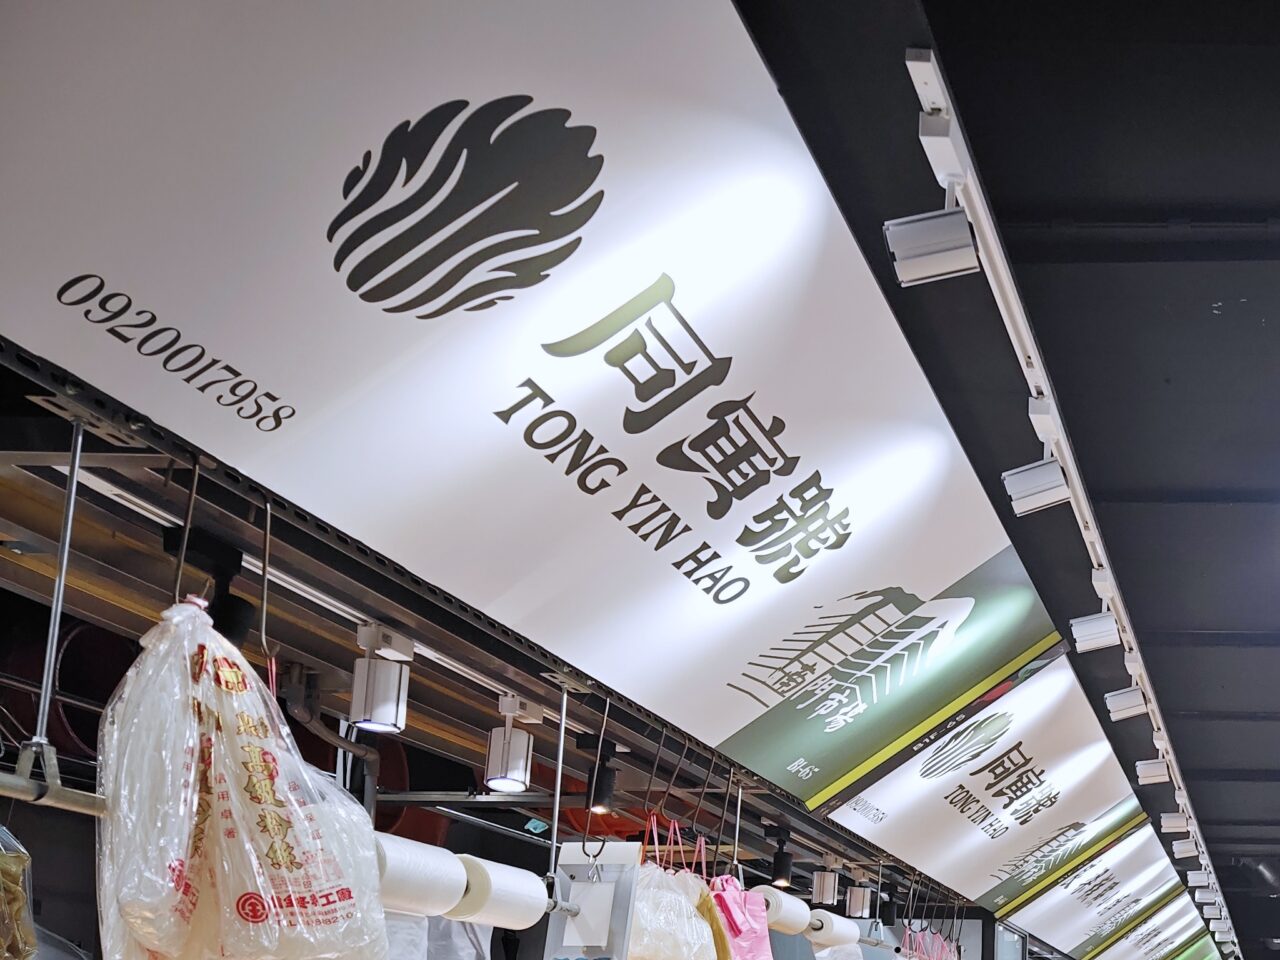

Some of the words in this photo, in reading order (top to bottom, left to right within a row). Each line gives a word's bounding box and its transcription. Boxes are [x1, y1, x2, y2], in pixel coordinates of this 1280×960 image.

[55, 273, 296, 434] 0920017958
[493, 377, 629, 497] TONG
[610, 484, 680, 553] YIN
[671, 538, 752, 606] HAO
[912, 713, 966, 752] B1F-65
[786, 757, 820, 780] B1-65
[943, 783, 980, 814] TONG
[967, 802, 995, 826] YIN
[981, 819, 1010, 840] HAO
